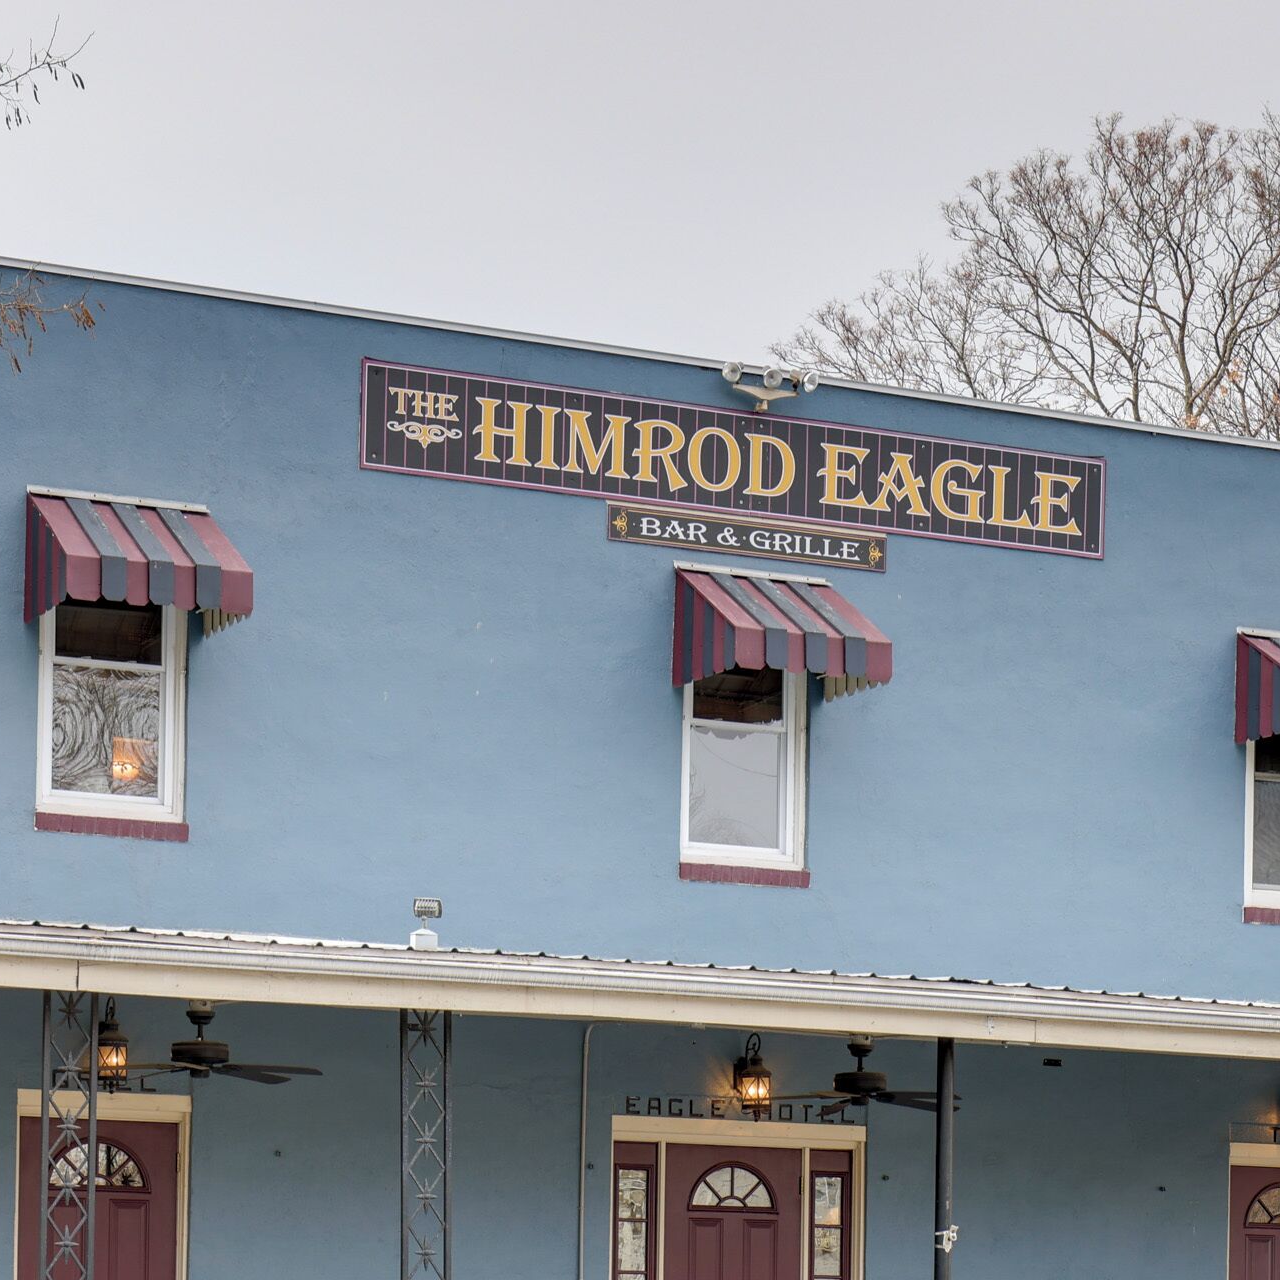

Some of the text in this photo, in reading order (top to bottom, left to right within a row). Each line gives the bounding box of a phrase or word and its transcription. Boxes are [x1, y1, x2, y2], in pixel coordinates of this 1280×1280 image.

[388, 386, 1083, 537] THE HIMROD EAGLE
[639, 517, 861, 562] BAR & GRILLE
[625, 1095, 725, 1119] EAGLE
